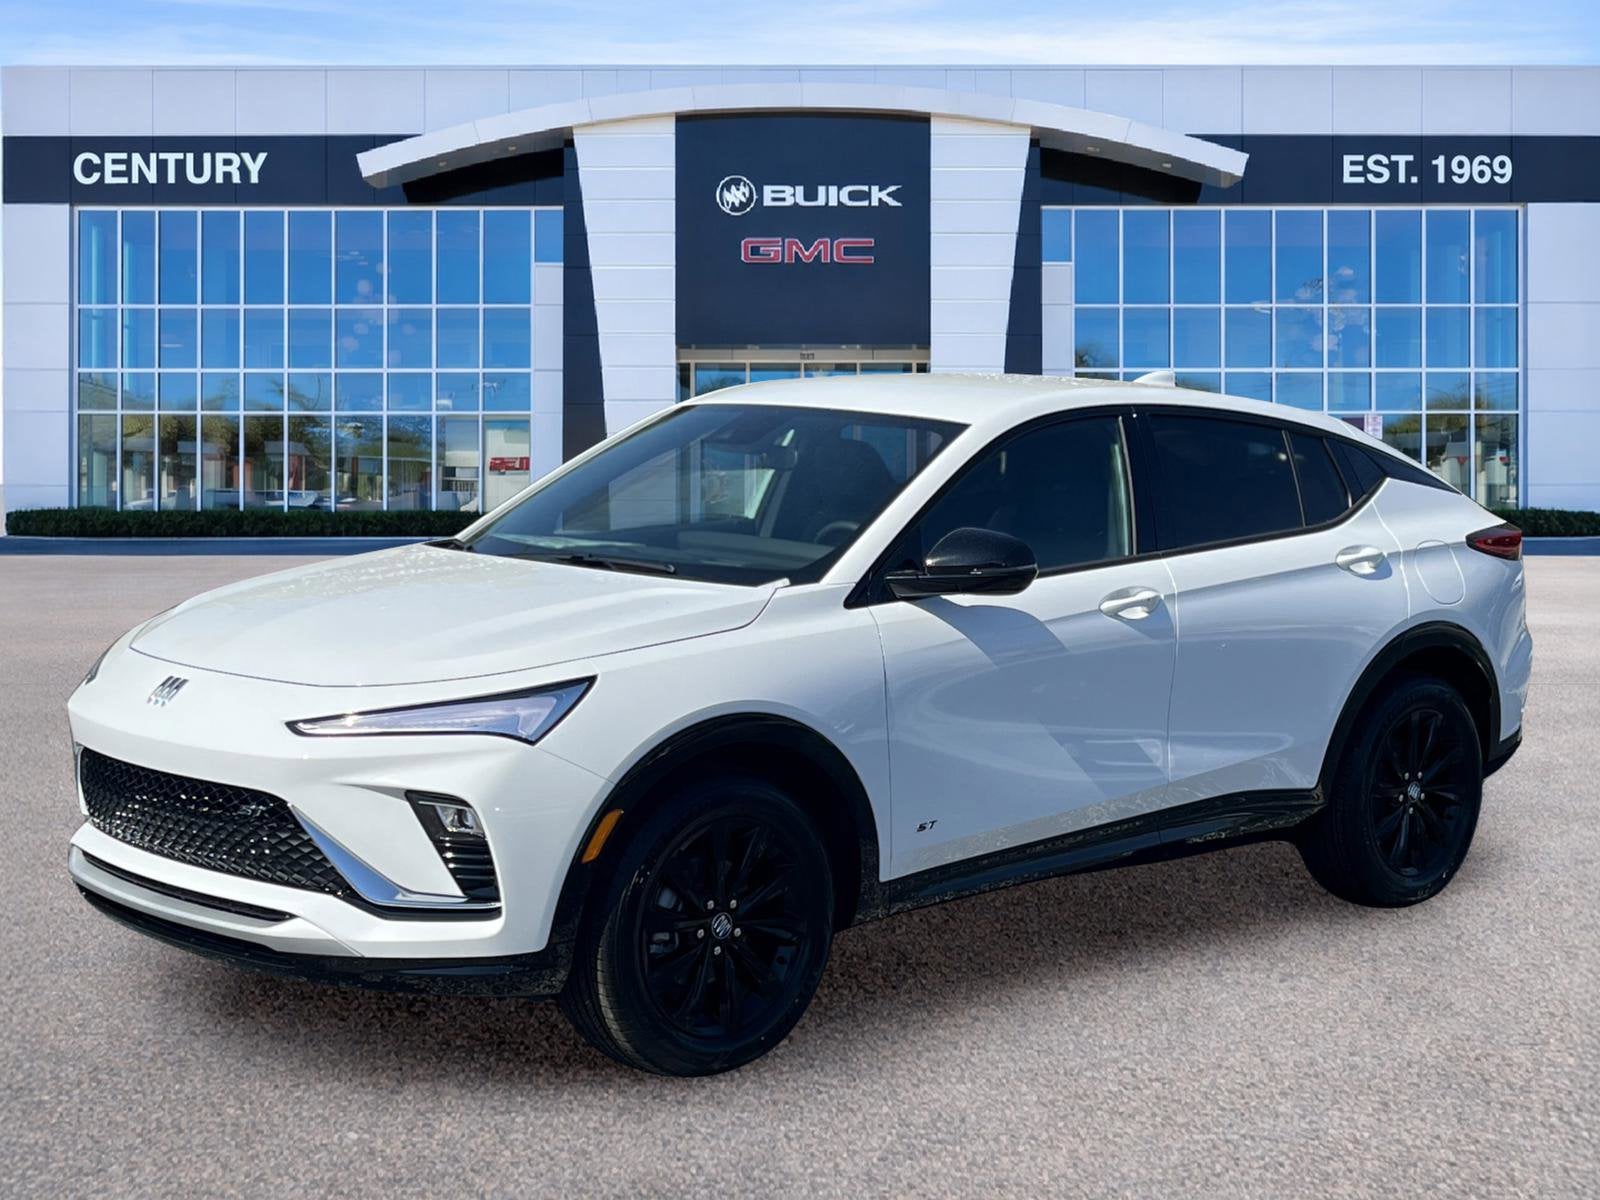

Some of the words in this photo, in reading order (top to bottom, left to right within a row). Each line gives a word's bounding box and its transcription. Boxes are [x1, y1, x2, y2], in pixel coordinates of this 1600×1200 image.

[73, 152, 268, 185] CENTURY
[1342, 154, 1418, 184] EST.
[1431, 154, 1513, 185] 1969
[763, 184, 903, 207] BUICK
[740, 237, 875, 264] GMC
[916, 819, 938, 833] ST
